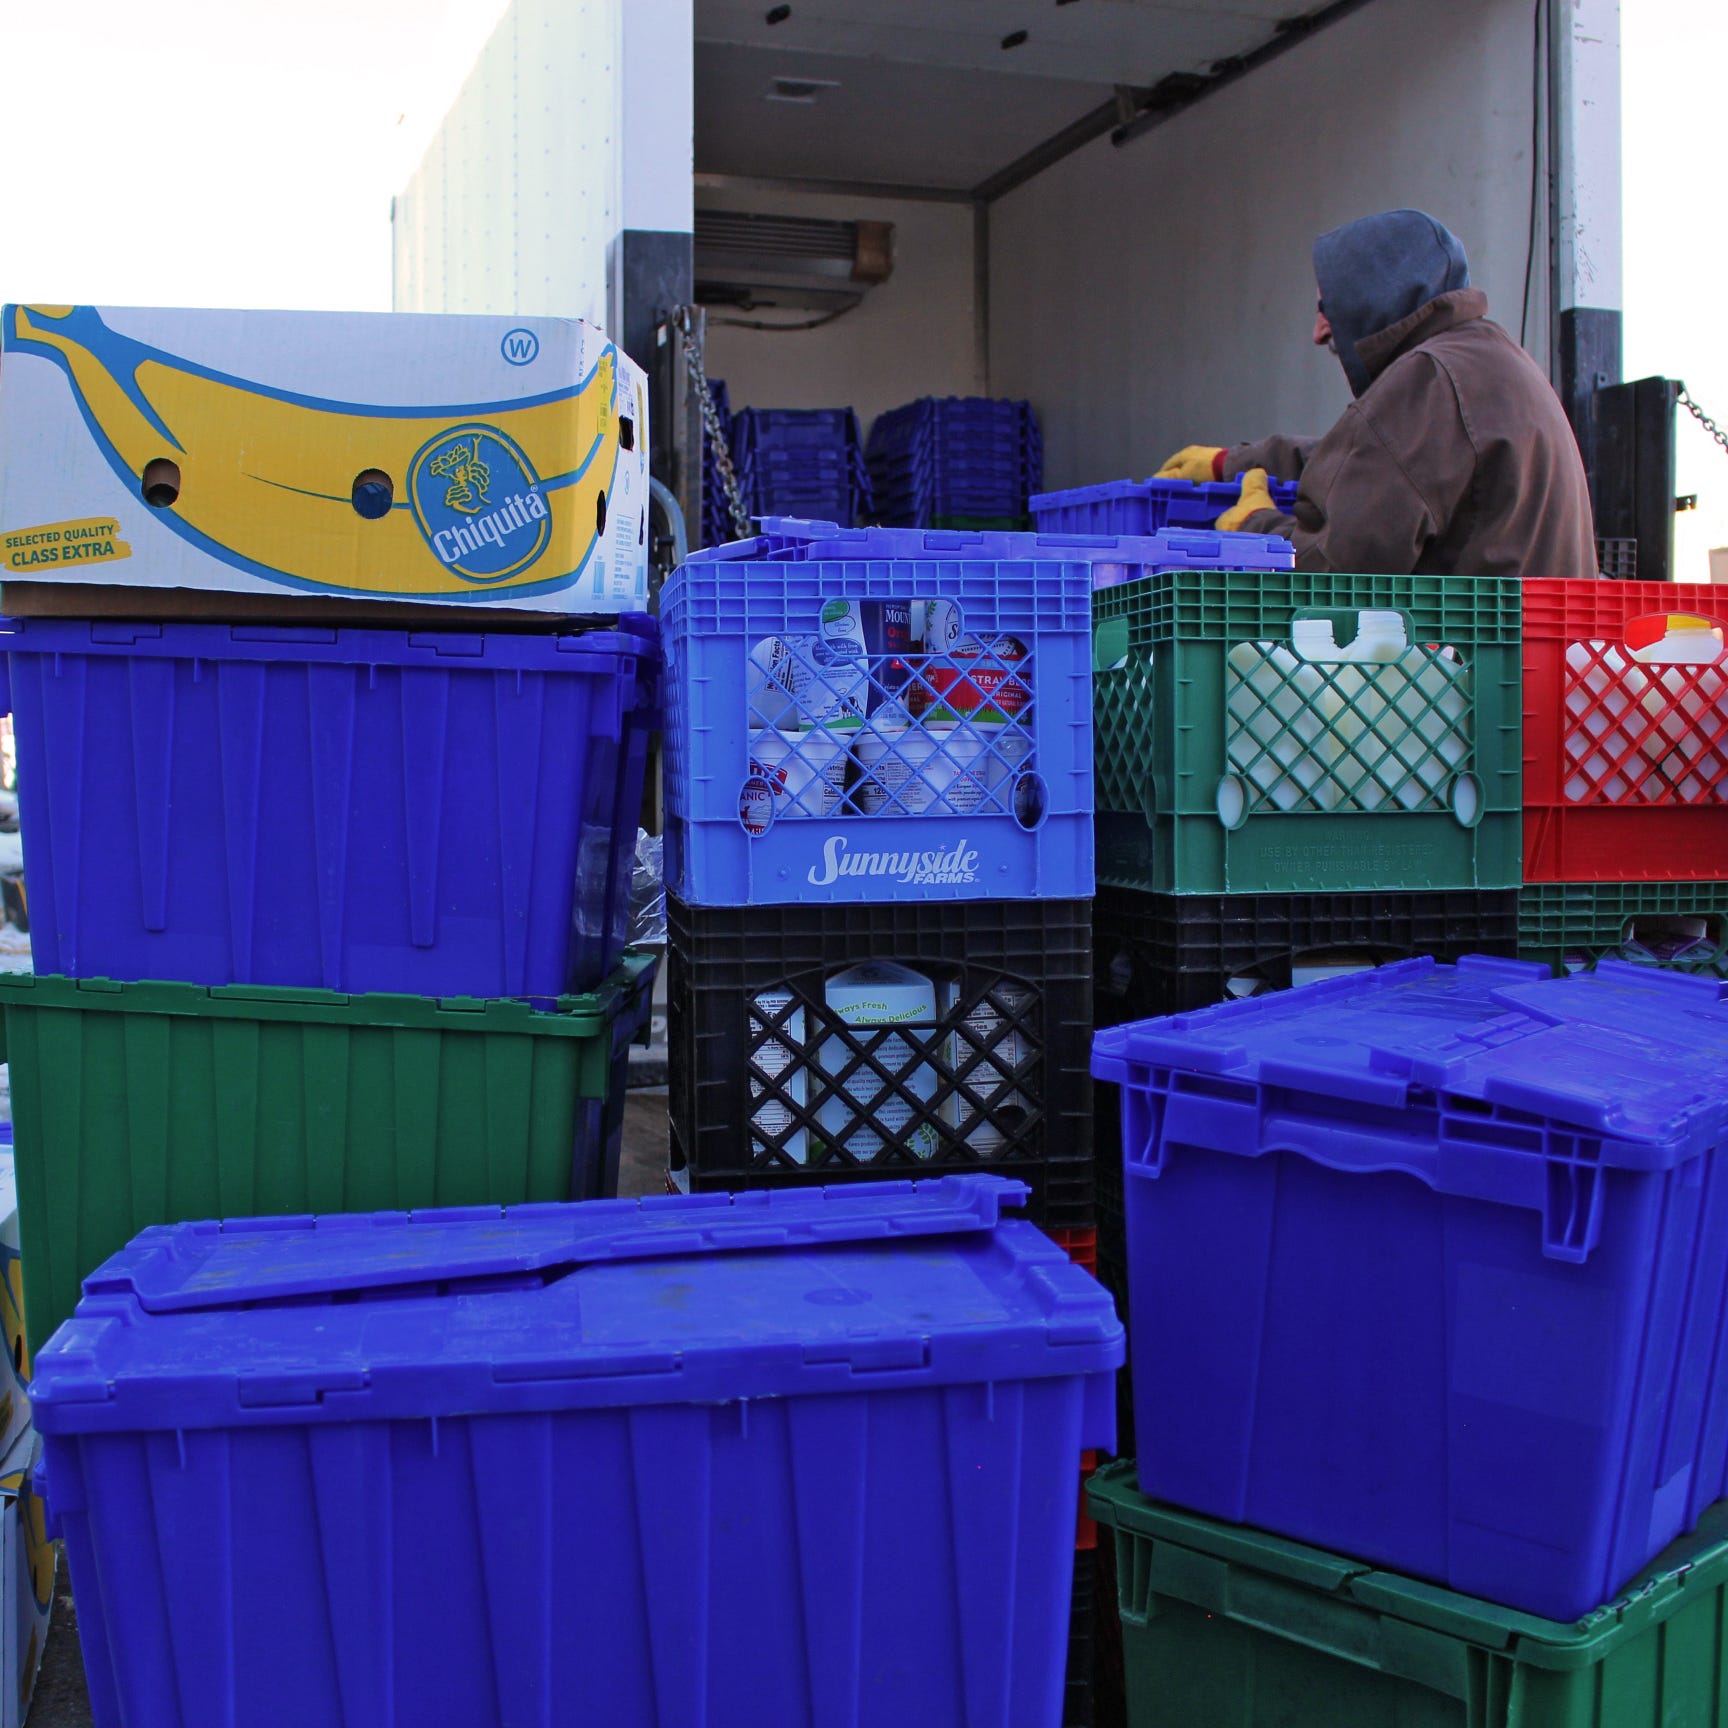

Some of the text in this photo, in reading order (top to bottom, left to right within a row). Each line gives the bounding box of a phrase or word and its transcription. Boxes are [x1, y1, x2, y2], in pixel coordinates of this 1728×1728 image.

[509, 338, 532, 359] W
[6, 524, 114, 548] SELECTED QUALITY
[432, 491, 550, 564] Chiquita
[12, 540, 115, 567] CLASS EXTRA
[807, 836, 980, 886] Sunnyside
[913, 872, 975, 885] FARMS
[855, 1004, 927, 1023] Always Delicious
[861, 1001, 888, 1011] Fresh
